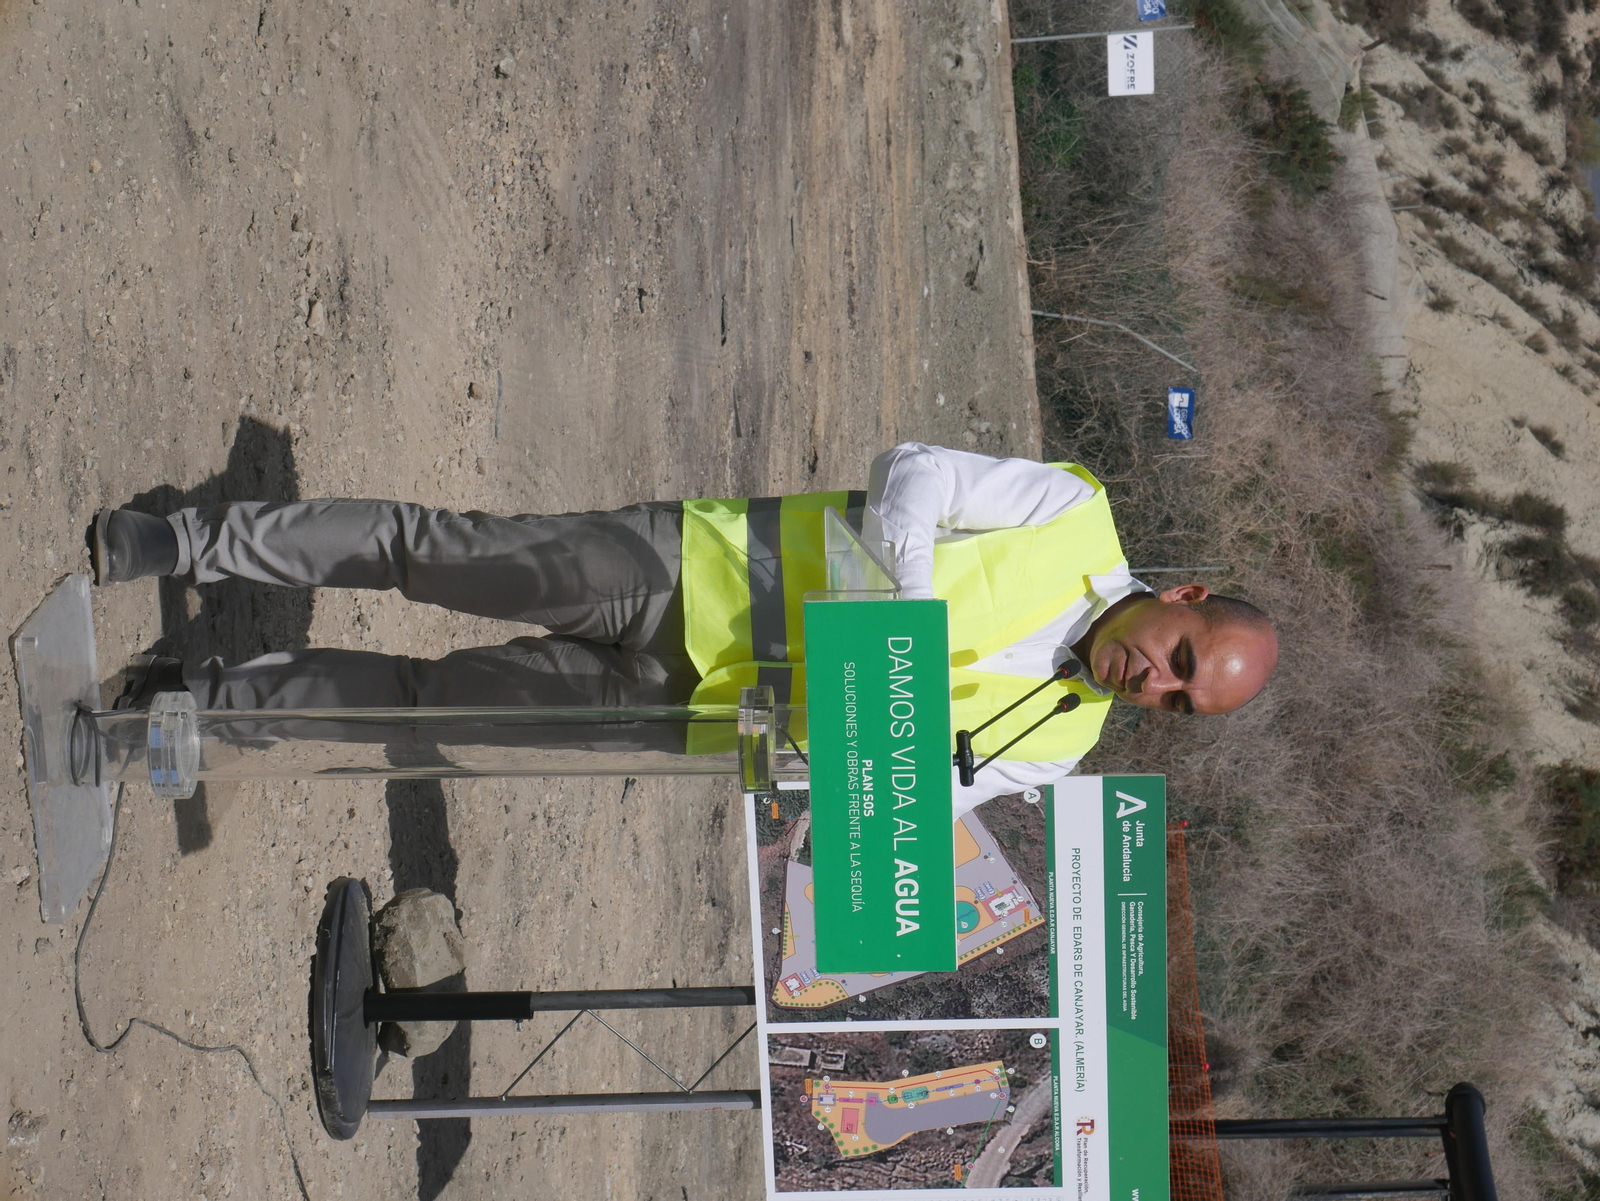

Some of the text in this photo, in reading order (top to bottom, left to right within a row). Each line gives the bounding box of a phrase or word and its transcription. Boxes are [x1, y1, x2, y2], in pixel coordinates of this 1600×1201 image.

[844, 662, 857, 738] SOLUCIONES
[847, 750, 859, 790] OBRAS
[862, 760, 874, 817] PLAN SOS
[888, 636, 920, 937] DAMOS VIDA AL AGUA
[848, 794, 860, 839] FRENTE
[1136, 820, 1145, 847] Junta
[850, 842, 860, 850] A
[850, 853, 861, 868] LA
[1122, 820, 1132, 882] de Andalucía
[850, 870, 865, 912] SEQUÍA
[1138, 933, 1144, 941] de
[1072, 848, 1087, 1092] PROYECTO DE EDARS DE CANJAYAR. (ALMERÍA)
